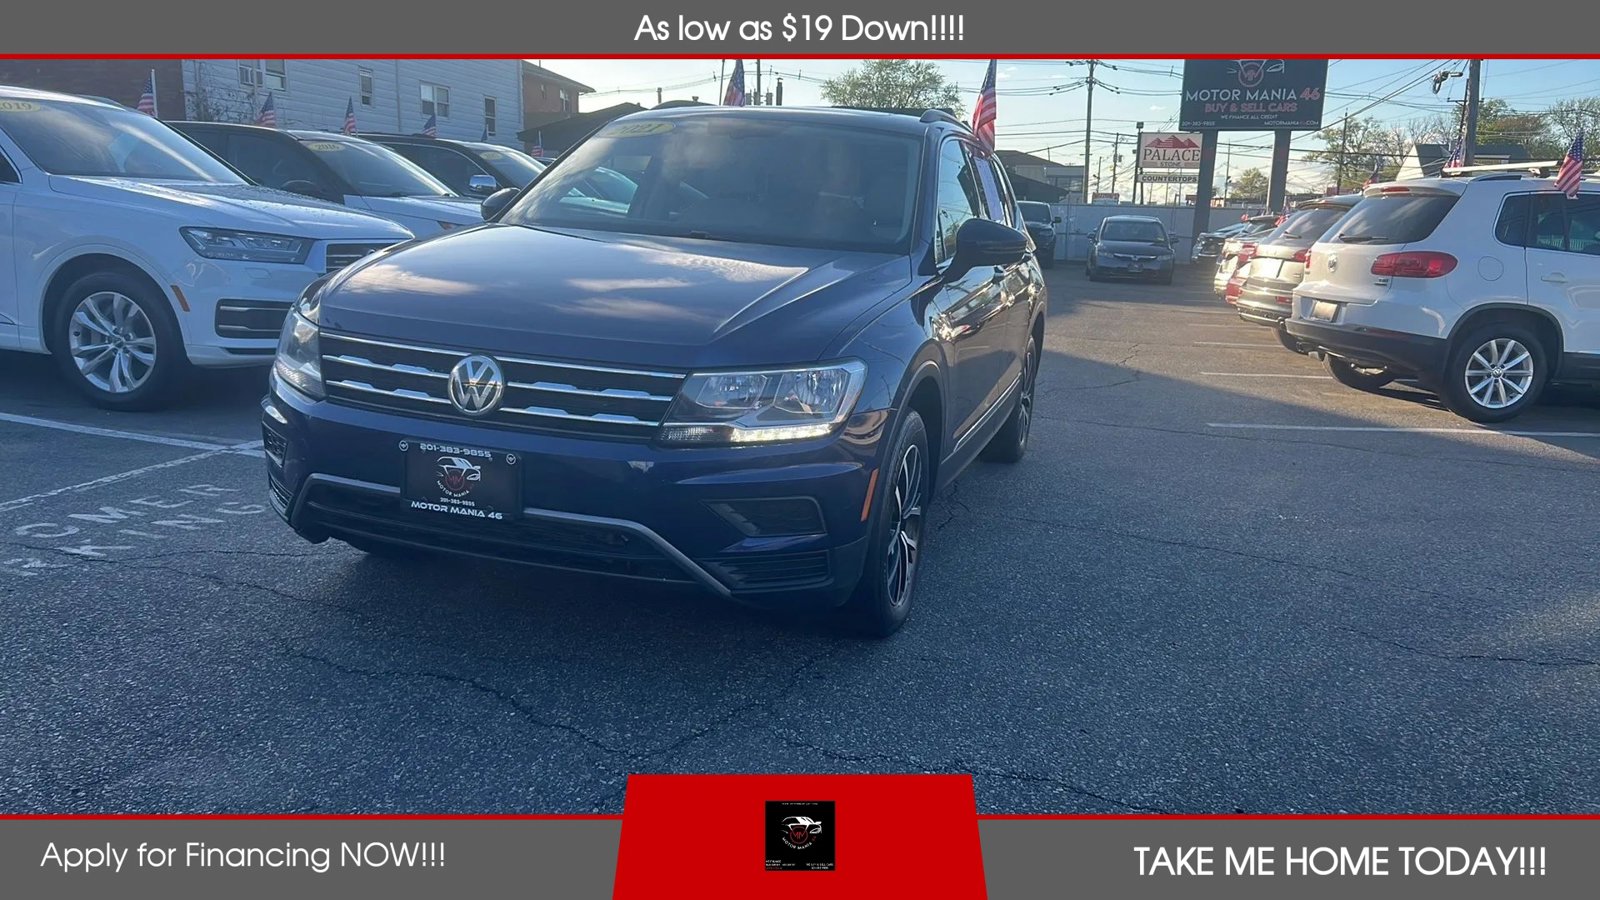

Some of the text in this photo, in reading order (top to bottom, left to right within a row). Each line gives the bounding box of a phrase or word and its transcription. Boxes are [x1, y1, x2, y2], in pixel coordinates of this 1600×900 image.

[1185, 87, 1321, 101] MOTOR MANIA 46
[0, 101, 32, 111] 019
[1204, 103, 1229, 113] BUY
[1241, 103, 1266, 113] SELL
[1268, 102, 1298, 113] CARS
[1143, 148, 1201, 162] PALACE
[419, 442, 492, 458] 201-383-9855
[410, 500, 503, 520] MOTOR MANIA 46
